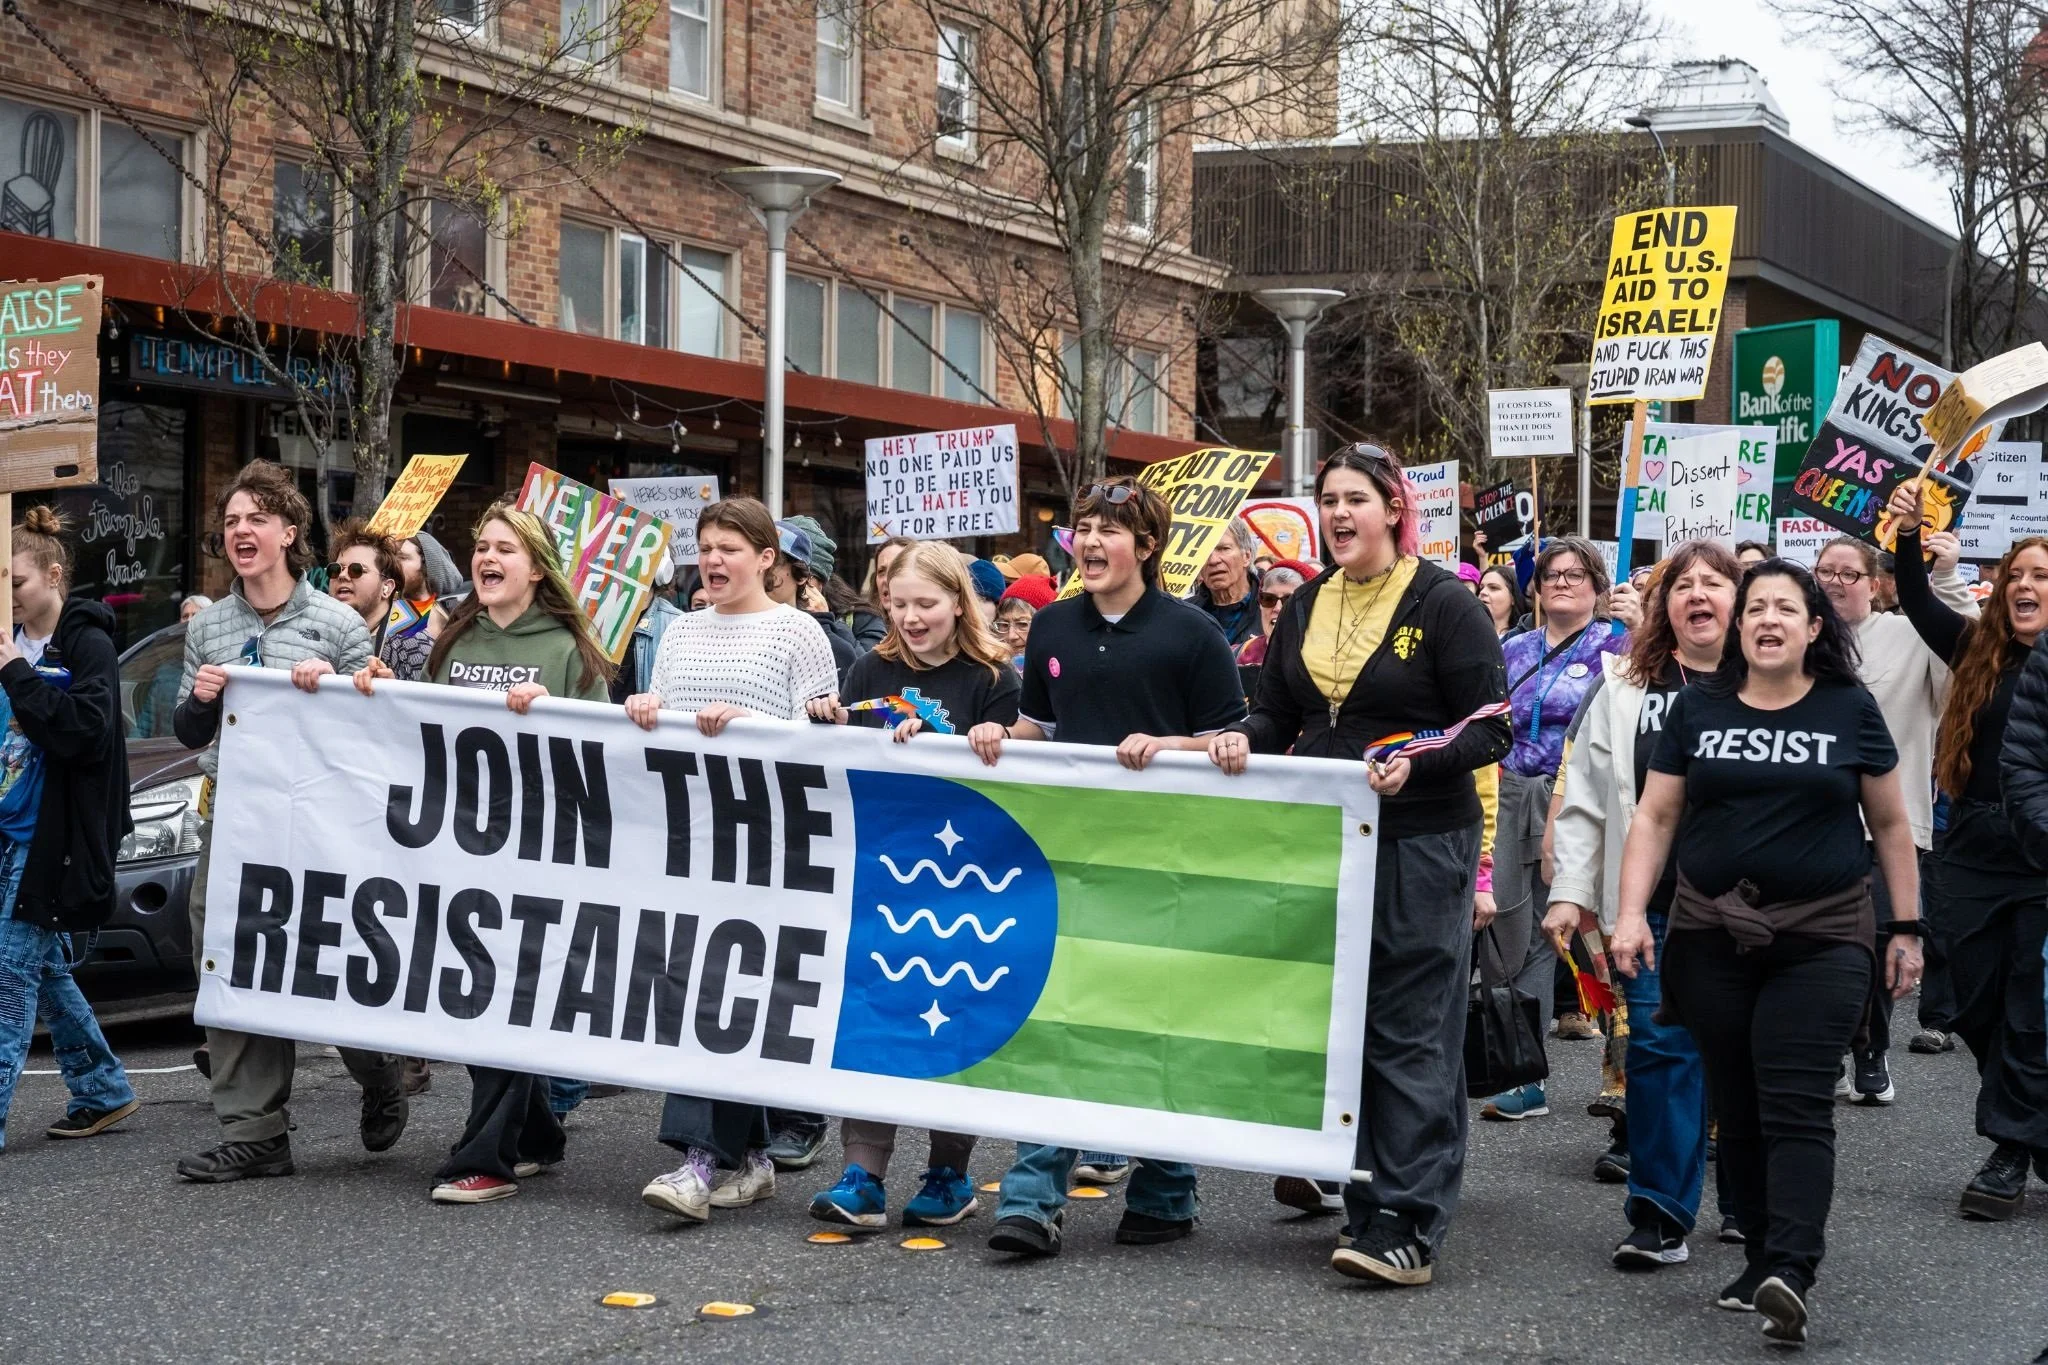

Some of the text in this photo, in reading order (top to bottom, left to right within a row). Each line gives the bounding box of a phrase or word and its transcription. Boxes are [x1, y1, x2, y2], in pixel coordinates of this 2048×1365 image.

[1632, 211, 1708, 251] END
[1610, 250, 1723, 280] ALL U.S.
[1612, 278, 1710, 305] AID TO
[0, 284, 83, 334] AISE
[1598, 308, 1717, 339] ISRAEL!
[26, 340, 72, 375] they
[134, 333, 278, 387] TEMPLE
[1595, 337, 1709, 364] AND FUCK THIS
[1590, 366, 1705, 392] STUPID IRAN WAR
[1866, 352, 1941, 409] NO
[0, 371, 93, 417] AT them
[1507, 401, 1532, 409] COSTS
[1739, 391, 1812, 418] Bank of the
[1532, 411, 1563, 419] PEOPLE
[1843, 383, 1924, 443] KINGS
[882, 428, 995, 457] HEY TRUMP
[1738, 439, 1769, 465] RE
[866, 445, 1014, 478] NO ONE PAID US
[1172, 450, 1231, 483] OUT
[1223, 453, 1271, 483] OF
[1671, 455, 1731, 487] Dissent
[1825, 437, 1895, 484] YAS
[883, 468, 996, 497] TO BE HERE
[1997, 472, 2014, 482] for
[632, 484, 697, 503] HERE'S SOME
[867, 485, 1013, 517] WE'LL HATE YOU
[1414, 487, 1454, 502] erican
[1479, 483, 1513, 508] STOP THE
[1690, 489, 1705, 509] is
[1793, 467, 1884, 524] QUEENS
[1420, 500, 1453, 518] amed
[1475, 495, 1515, 526] VIOLENCE
[2009, 514, 2048, 522] Accounta
[523, 473, 664, 577] NEVER
[900, 512, 994, 536] FOR FREE
[1420, 520, 1433, 533] of
[1665, 509, 1733, 547] Patriotic!
[2009, 526, 2048, 534] Self-Aware
[675, 543, 699, 557] THEI
[1167, 521, 1214, 557] TY!
[1423, 536, 1458, 561] ump!
[1960, 538, 1979, 548] ust
[1160, 560, 1197, 577] BOR!
[1694, 727, 1837, 765] RESIST
[386, 722, 836, 894] JOIN THE
[230, 862, 828, 1066] RESISTANCE
